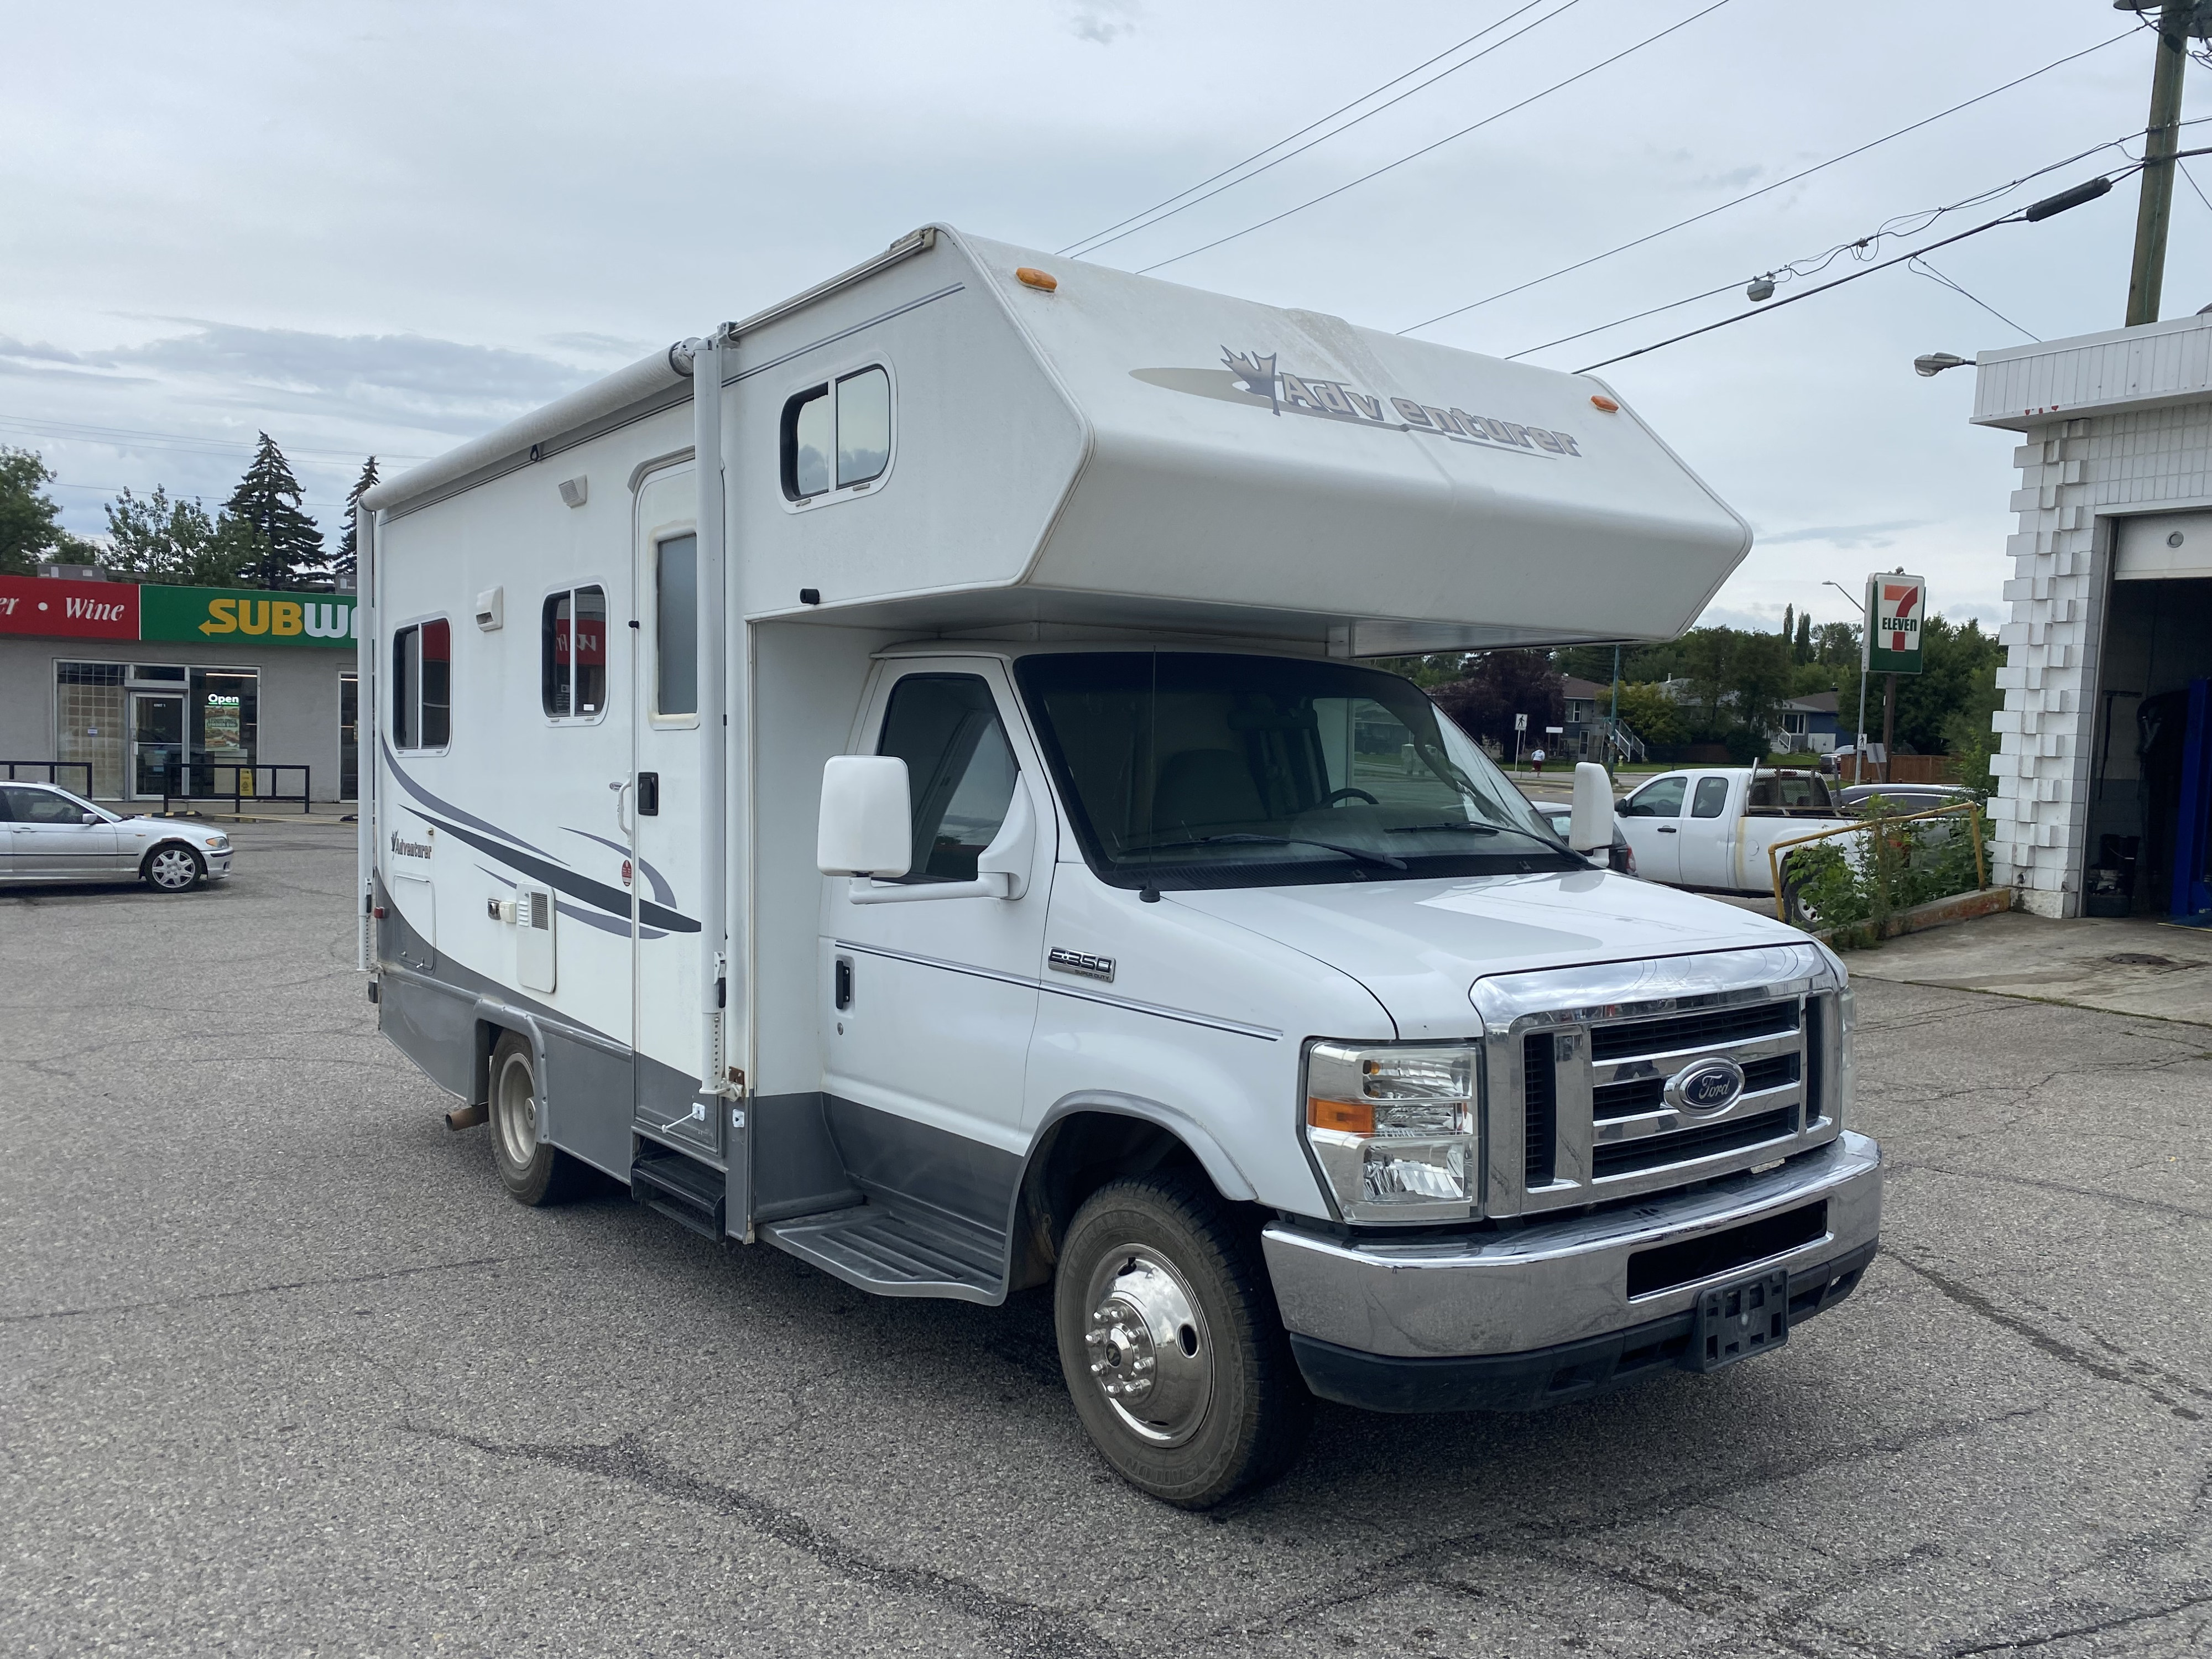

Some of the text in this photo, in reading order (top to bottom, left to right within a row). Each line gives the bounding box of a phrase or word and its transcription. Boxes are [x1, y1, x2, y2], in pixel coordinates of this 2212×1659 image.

[65, 597, 125, 622] Wine
[1884, 584, 1918, 651] 7
[208, 693, 239, 705] Open
[395, 838, 432, 859] Adventurer
[1698, 1074, 1730, 1099] Ford
[1124, 1457, 1199, 1485] SAILUN
